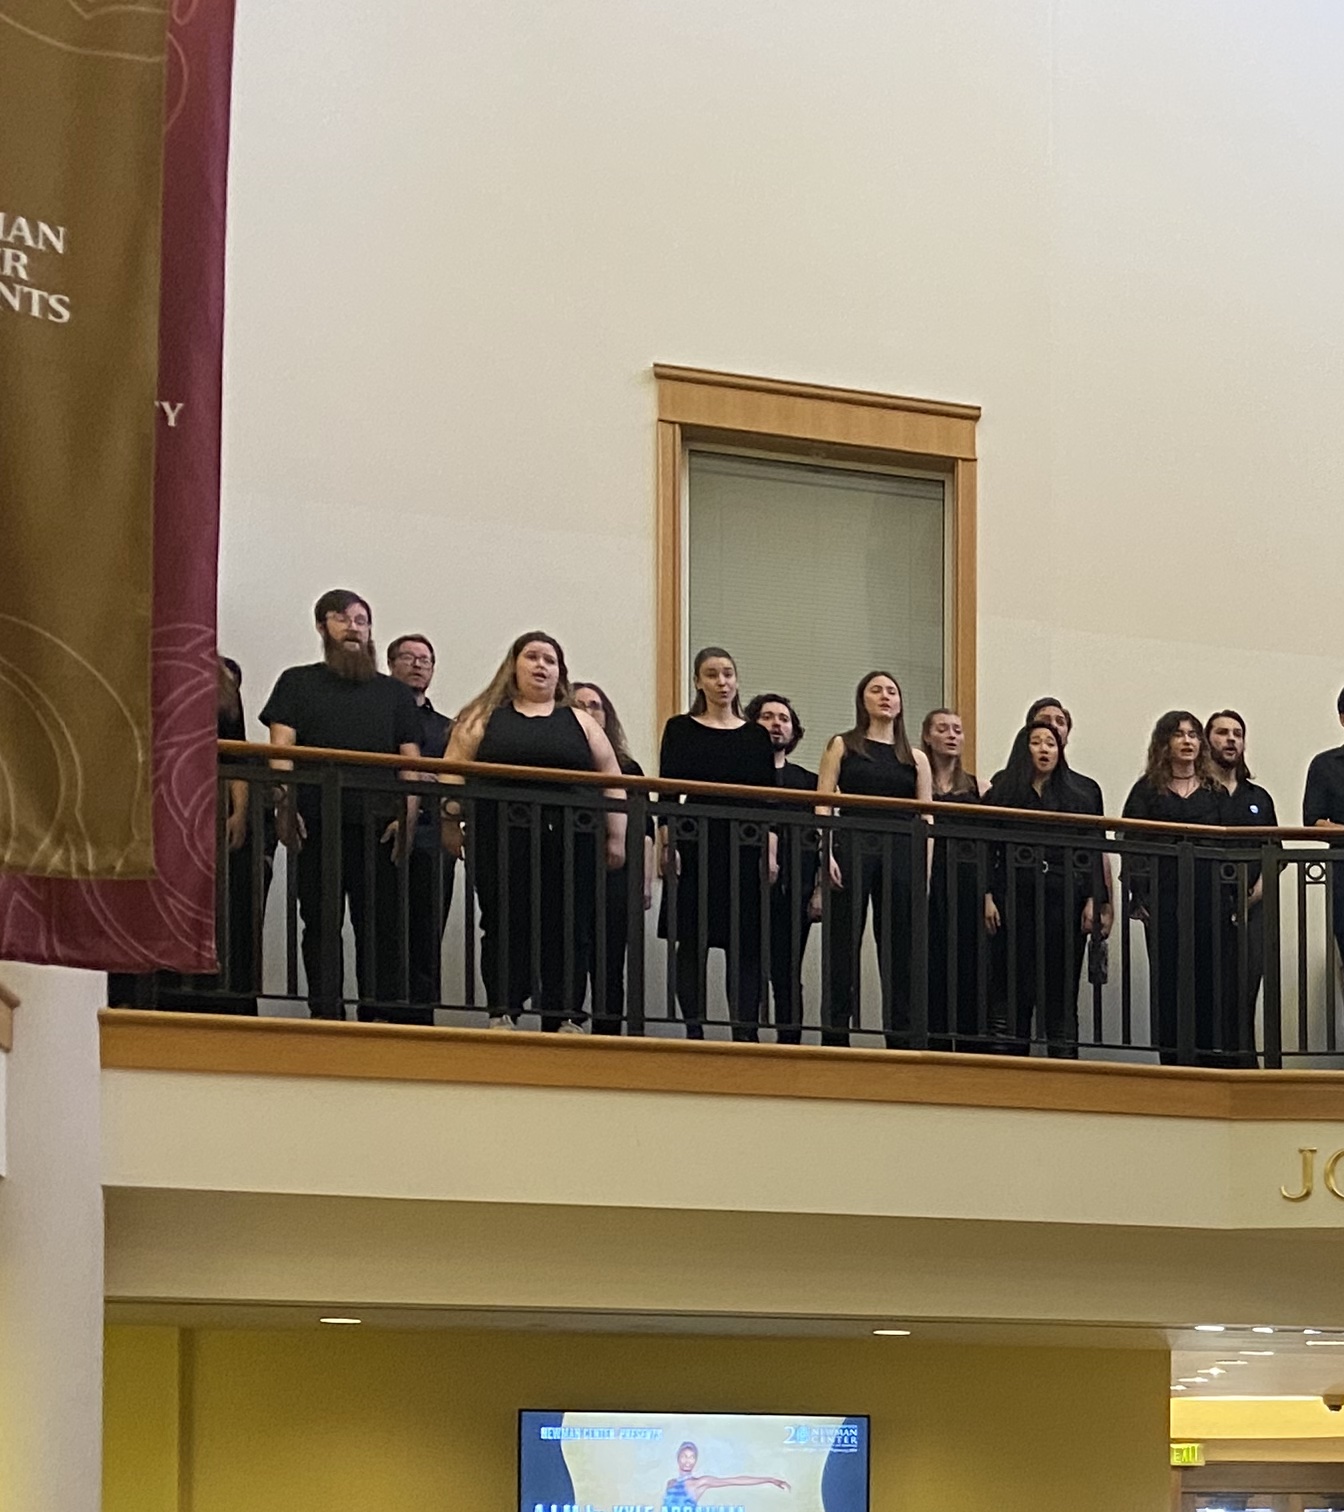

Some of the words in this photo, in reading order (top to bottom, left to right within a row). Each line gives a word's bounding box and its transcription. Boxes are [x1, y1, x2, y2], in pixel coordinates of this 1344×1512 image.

[0, 212, 66, 254] AN
[0, 247, 29, 281] R
[1173, 1446, 1198, 1463] EXIT
